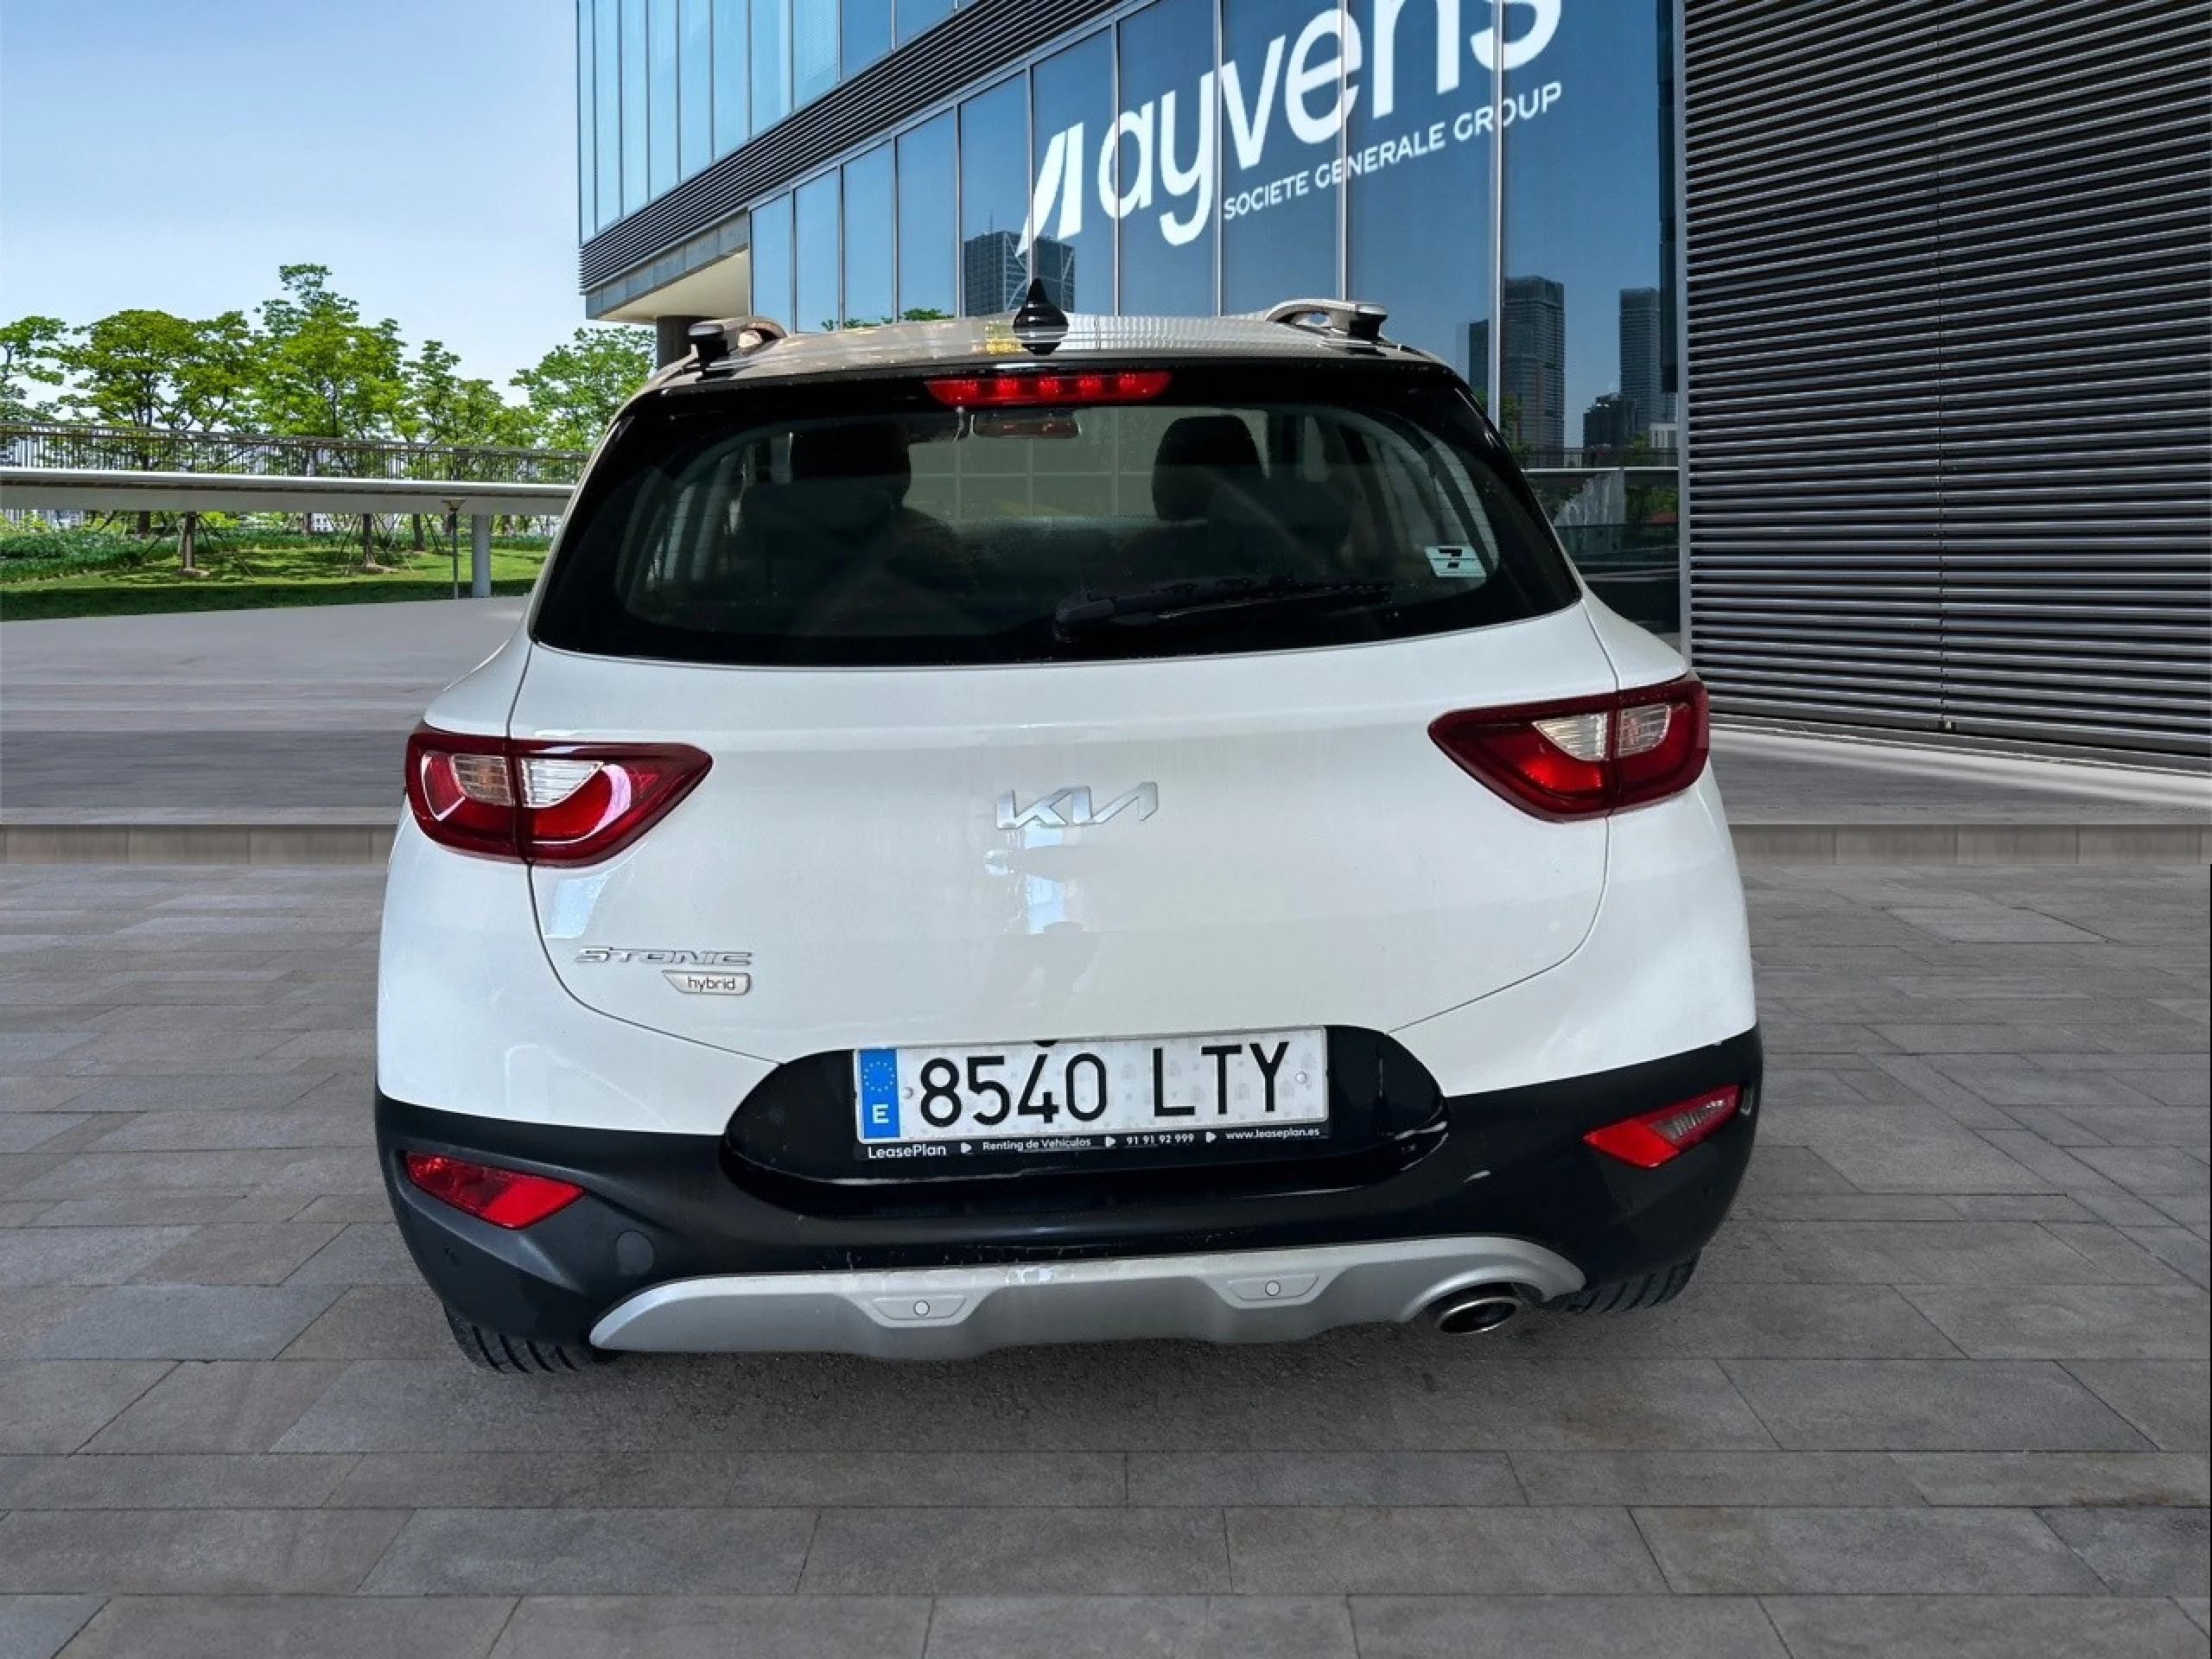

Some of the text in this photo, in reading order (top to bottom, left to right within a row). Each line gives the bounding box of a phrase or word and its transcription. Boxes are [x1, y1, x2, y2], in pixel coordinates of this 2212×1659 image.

[1224, 80, 1562, 220] SOCIETE GENERALE GROUP
[996, 781, 1159, 830] KIA
[574, 945, 753, 966] STONIC
[687, 976, 735, 993] hybrid
[920, 1041, 1289, 1128] 8540 LTY
[872, 1103, 889, 1124] E
[1126, 1136, 1139, 1146] 91
[1142, 1135, 1155, 1145] 91
[1175, 1133, 1195, 1143] 999
[1225, 1127, 1319, 1140] www.leaseplan.es
[868, 1144, 947, 1160] LeasePlan
[982, 1140, 1024, 1152] Renting
[1027, 1138, 1039, 1149] de
